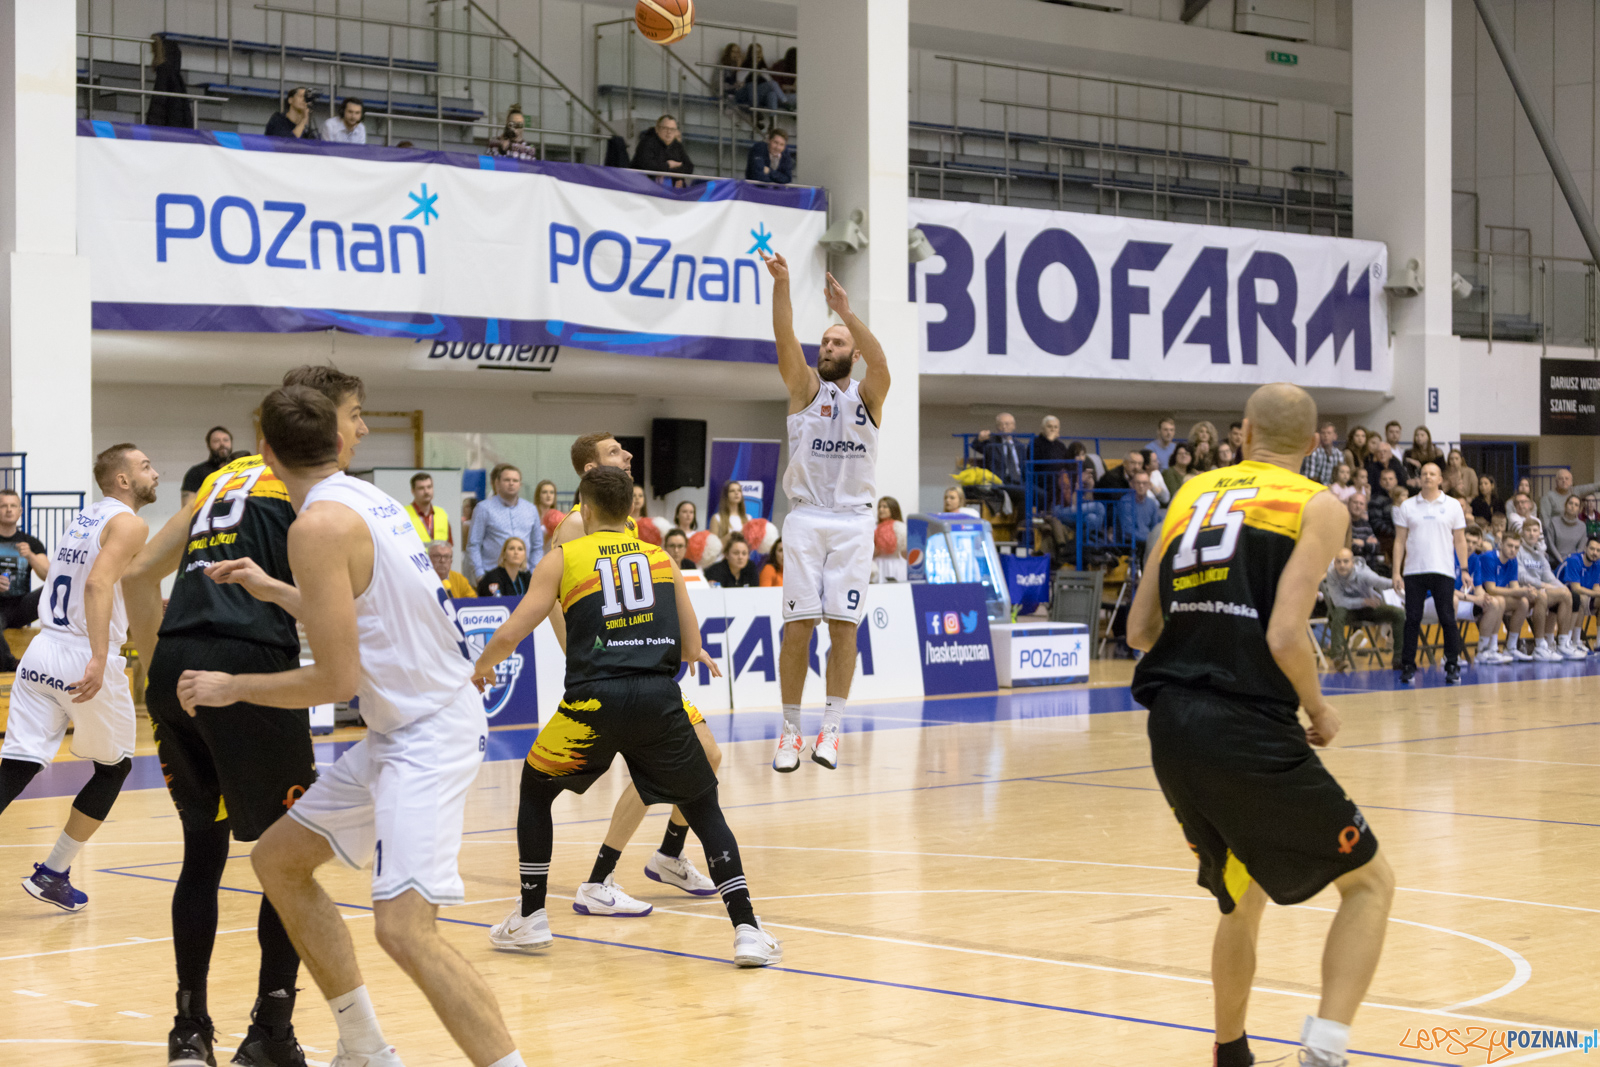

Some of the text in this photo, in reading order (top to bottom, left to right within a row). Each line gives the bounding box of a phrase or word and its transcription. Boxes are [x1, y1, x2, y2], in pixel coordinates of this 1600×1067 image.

[1550, 375, 1579, 391] DARIUSZ
[1430, 391, 1437, 410] E
[1550, 399, 1577, 413] SZATNIE
[855, 403, 867, 426] 9
[1214, 476, 1258, 489] KLIMA
[190, 464, 267, 537] 13
[1172, 487, 1260, 573] 15
[598, 542, 640, 556] WIELOCH
[593, 552, 656, 618] 10
[50, 575, 72, 626] 0
[847, 589, 860, 610] 9
[463, 615, 502, 625] BIOFARM
[606, 636, 675, 647] Anocote Polska
[925, 640, 990, 666] /basketpoznan
